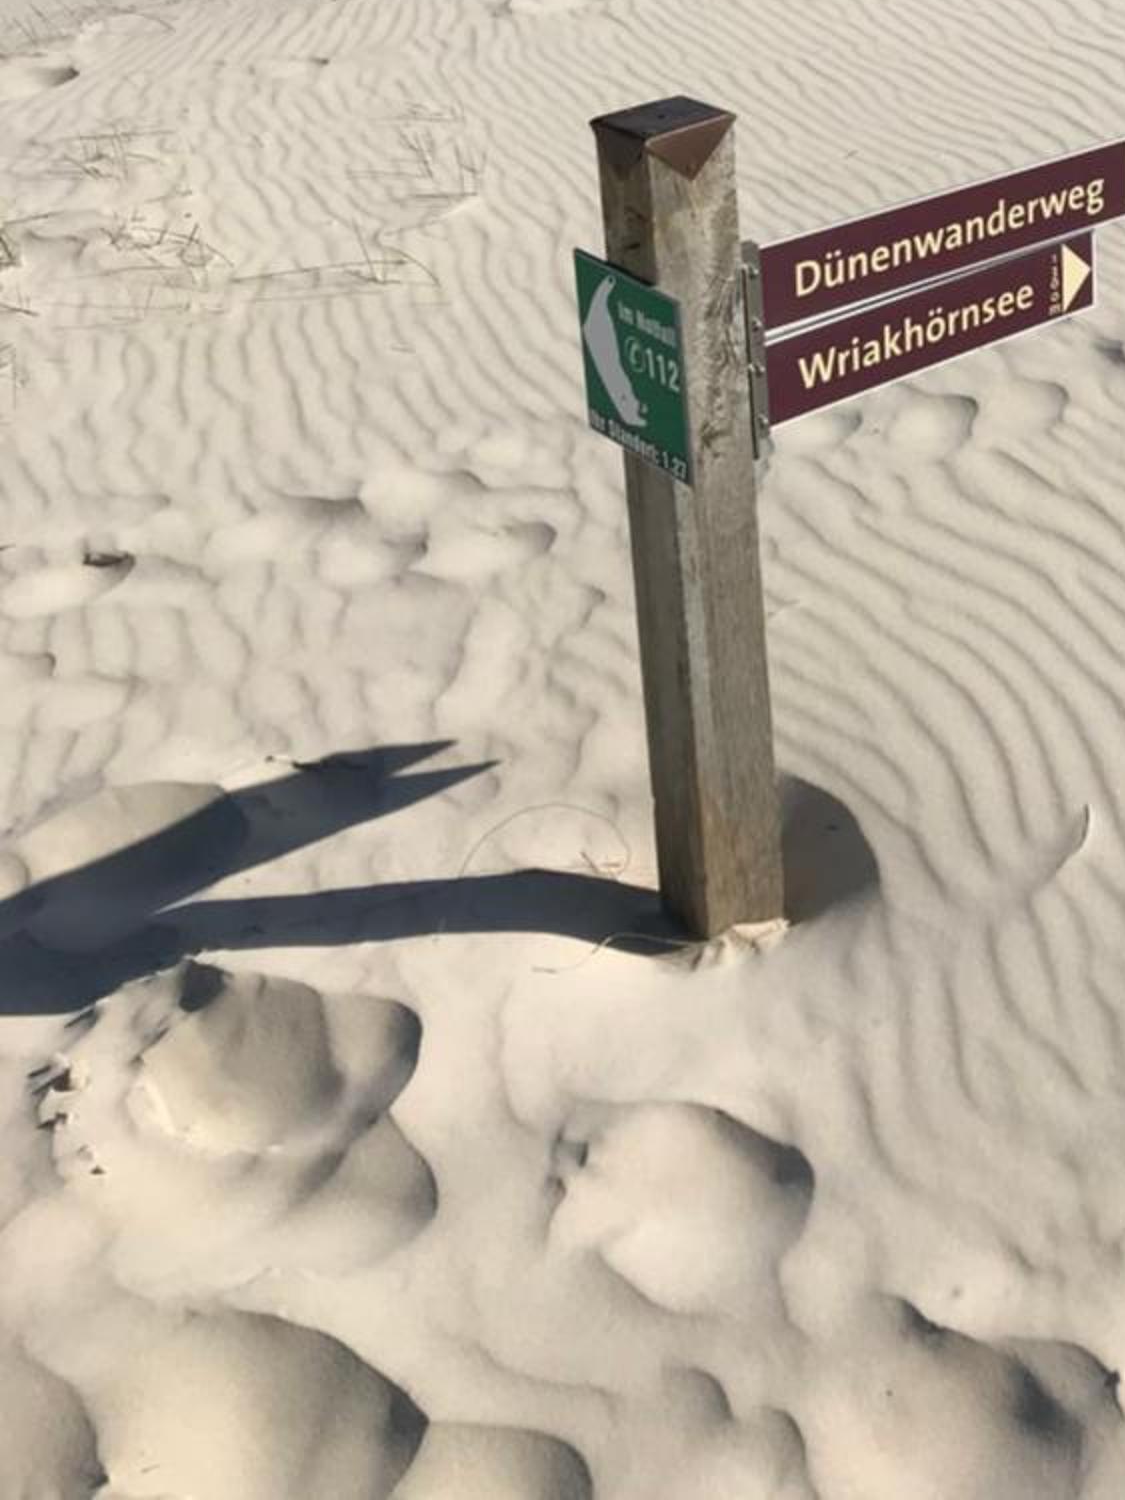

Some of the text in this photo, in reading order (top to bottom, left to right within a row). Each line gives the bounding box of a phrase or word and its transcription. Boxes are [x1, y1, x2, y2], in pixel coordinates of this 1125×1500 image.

[795, 178, 1105, 297] Dünenwanderweg
[646, 347, 680, 392] 112
[798, 284, 1034, 389] Wriakhörnsee
